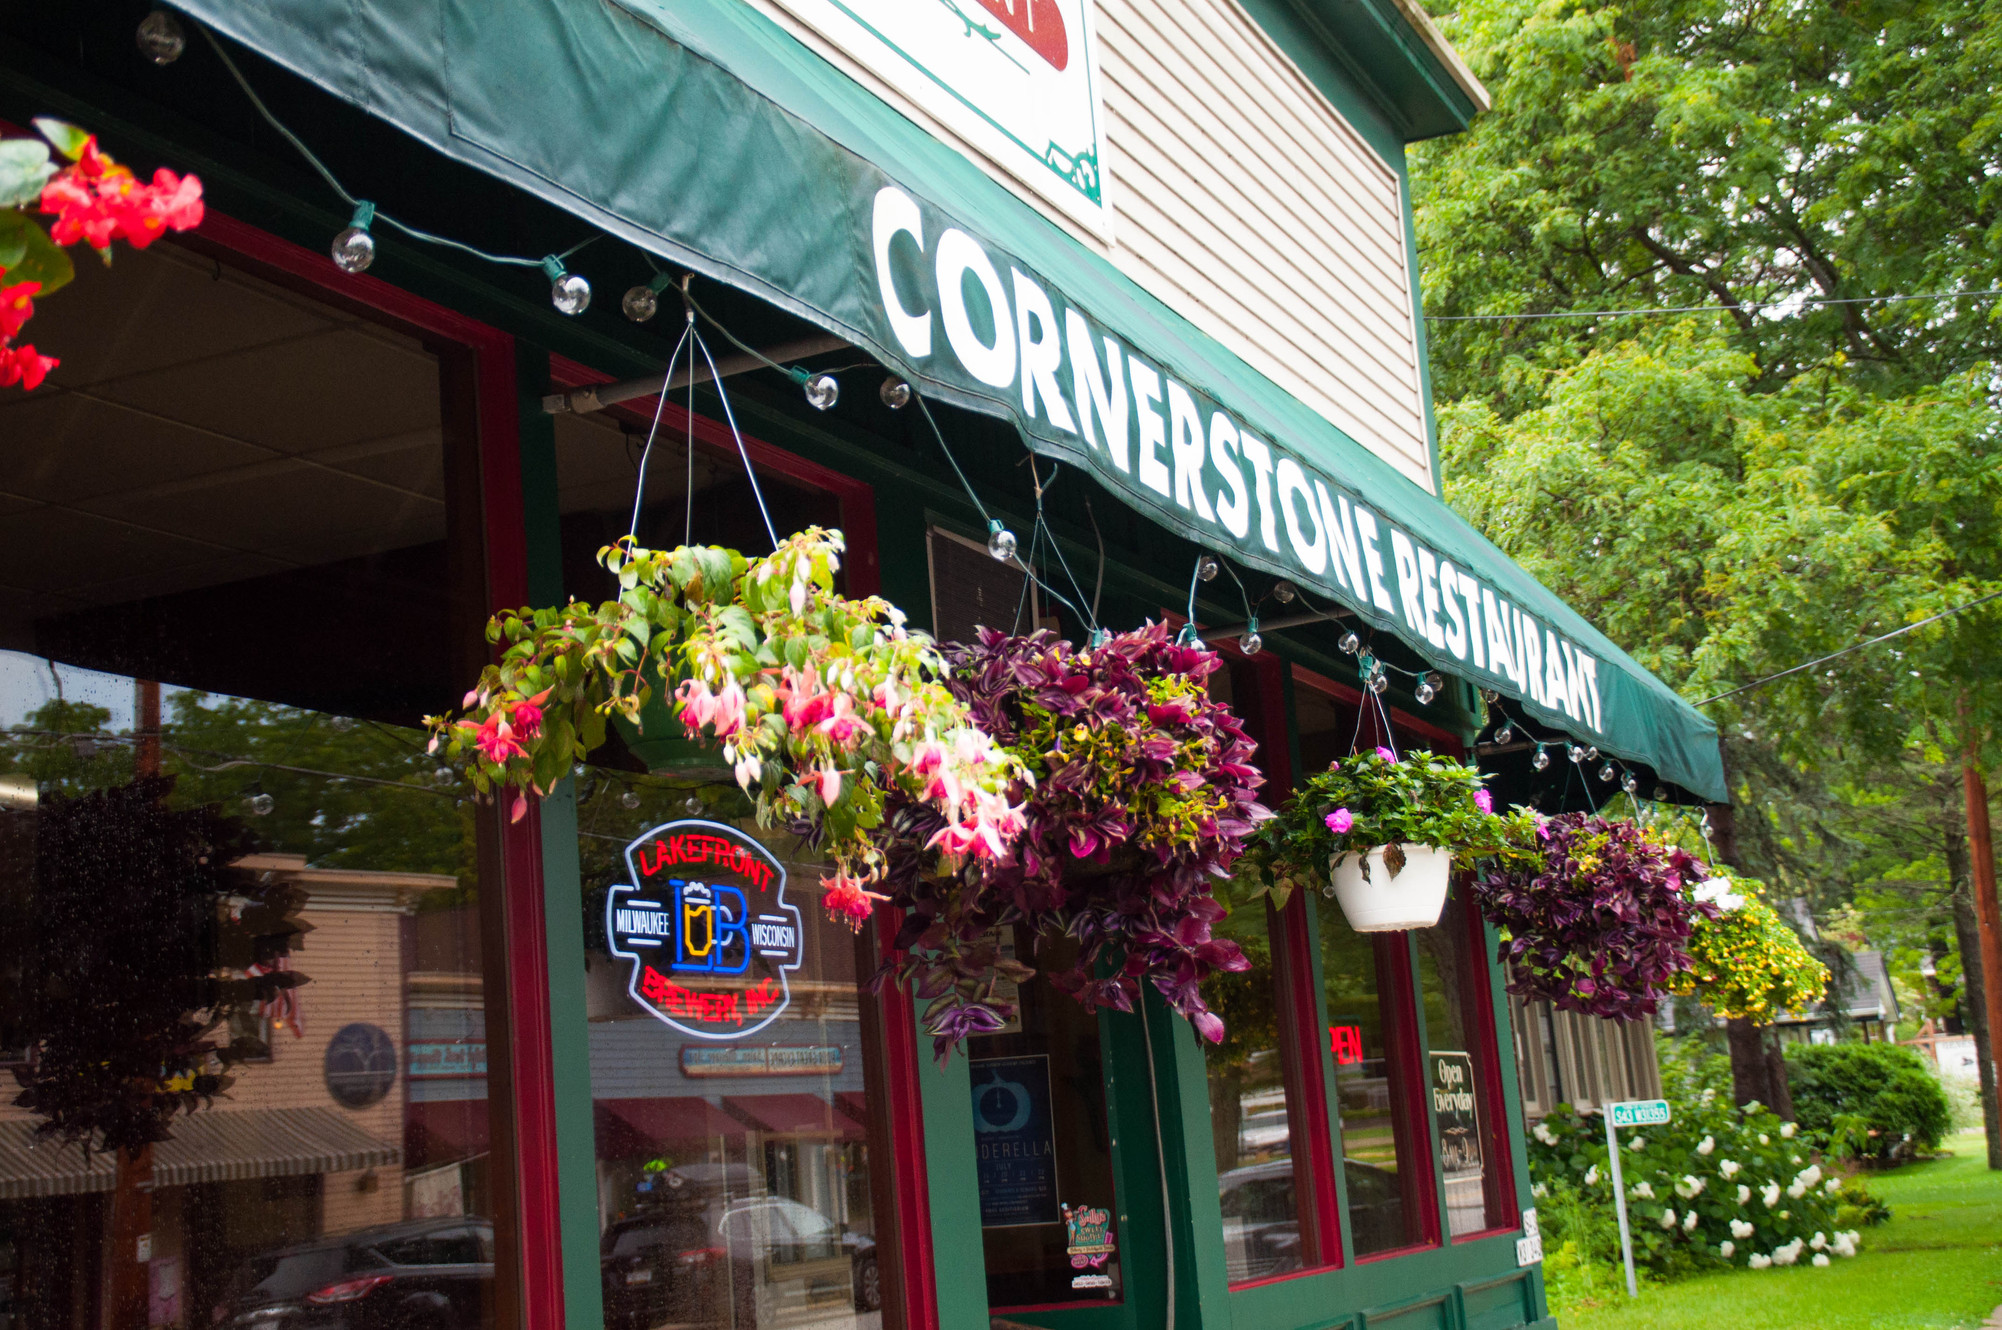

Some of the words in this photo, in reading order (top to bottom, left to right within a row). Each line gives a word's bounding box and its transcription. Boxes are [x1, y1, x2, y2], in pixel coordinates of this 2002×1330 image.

[872, 186, 1395, 617] CORNERSTONE
[1391, 528, 1602, 733] RESTAURANT
[639, 834, 775, 892] LAKEFRONT
[616, 908, 670, 936] MILWAUKEE
[752, 923, 795, 948] WISCONSIN
[745, 977, 780, 1015] INC
[1328, 1025, 1364, 1065] PEN
[1438, 1058, 1463, 1090] Open
[1432, 1087, 1473, 1120] Everyday
[975, 1140, 1052, 1161] DERELLA
